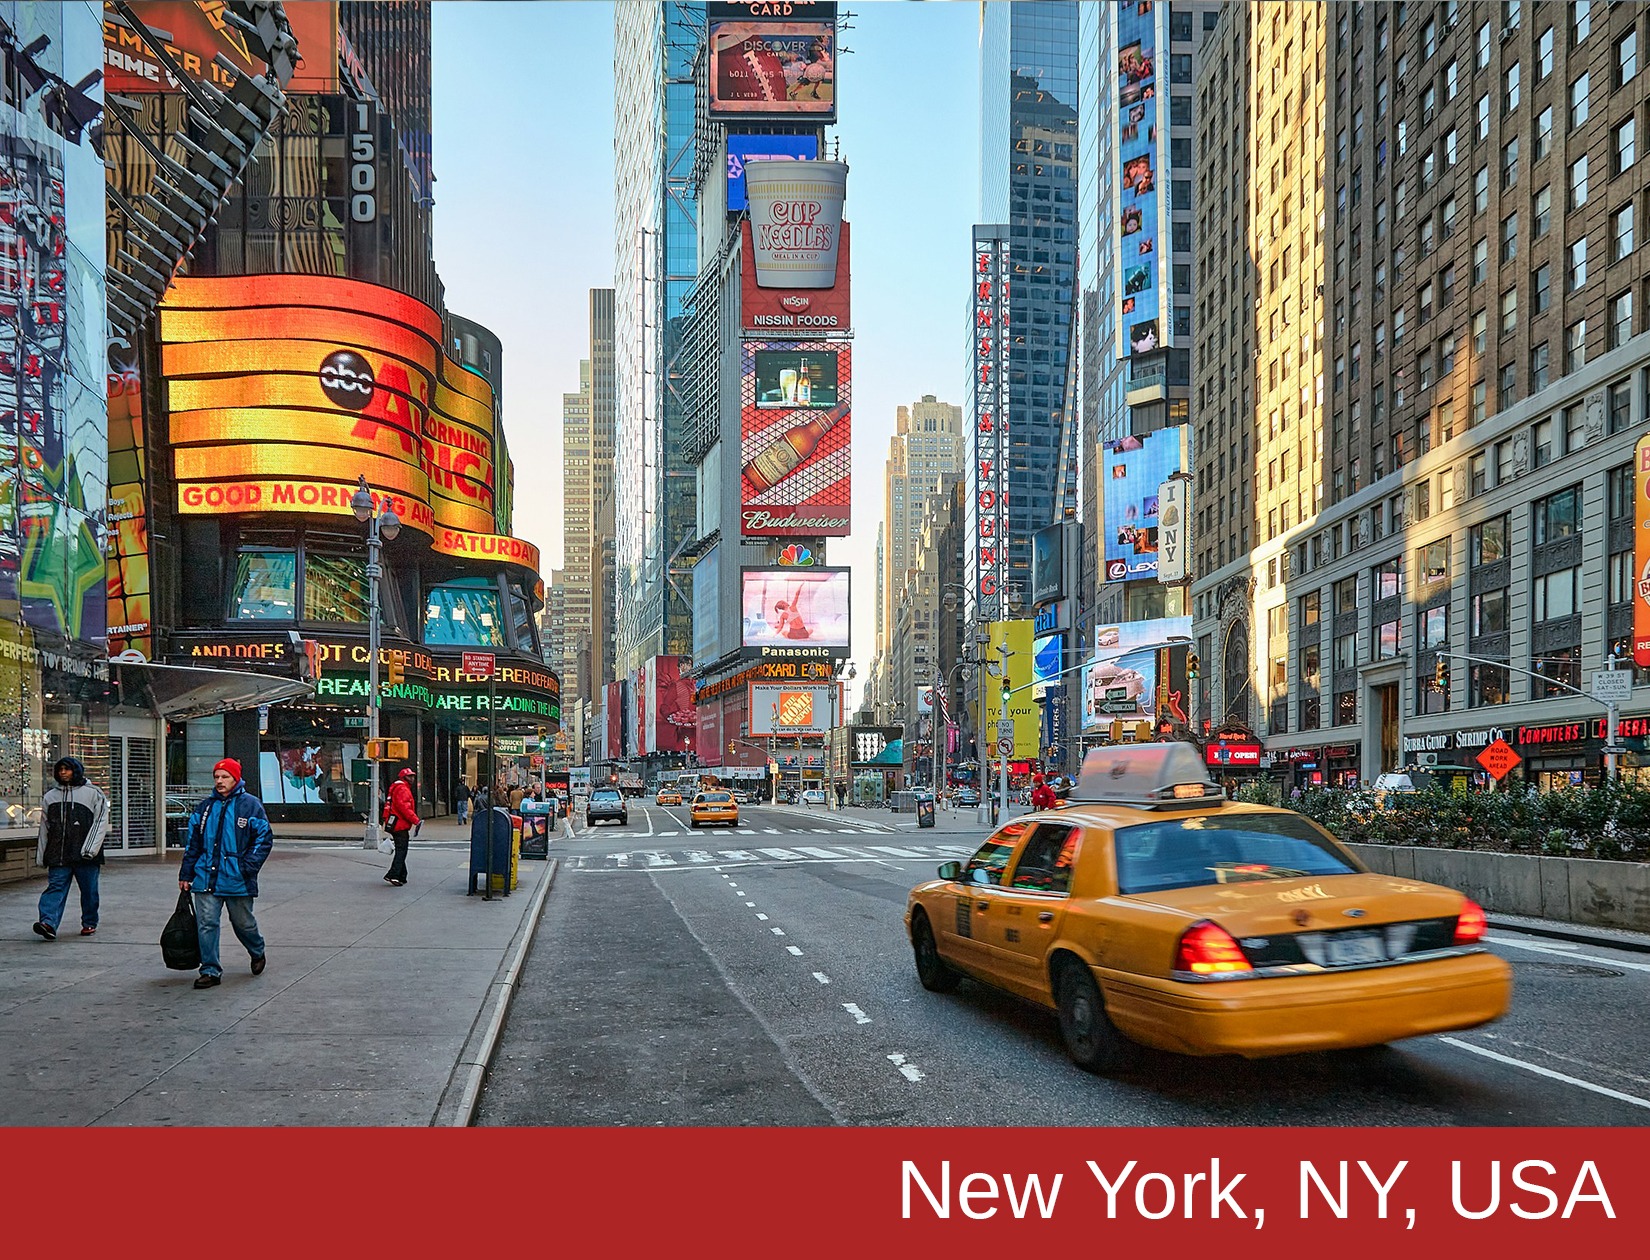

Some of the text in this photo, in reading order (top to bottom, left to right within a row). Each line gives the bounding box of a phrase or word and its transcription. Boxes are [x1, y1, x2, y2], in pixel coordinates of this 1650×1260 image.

[750, 4, 793, 16] CARD
[744, 40, 807, 52] DISCOVER
[351, 103, 376, 222] 1500
[769, 200, 822, 226] CUP
[758, 223, 833, 252] NOODLES
[783, 295, 809, 307] NISSIN
[753, 315, 838, 327] NISSIN FOODS
[319, 362, 375, 397] abc
[978, 253, 996, 596] ERNST & YOUNG
[183, 484, 262, 507] GOOD
[741, 511, 850, 530] Budweiser
[107, 623, 148, 635] RTAINER"
[320, 644, 347, 662] OT
[761, 646, 830, 657] Panasonic
[435, 695, 473, 710] ARE
[477, 695, 536, 713] READING
[780, 692, 813, 725] HOME
[782, 695, 797, 709] THE
[792, 703, 813, 725] DEPOT
[1010, 708, 1032, 718] your
[499, 739, 523, 747] RBUCKS
[1404, 736, 1425, 752] BUBBA
[1426, 734, 1447, 750] GUMP
[1455, 730, 1488, 748] SHRIMP
[1518, 724, 1579, 745] COMPUTERS
